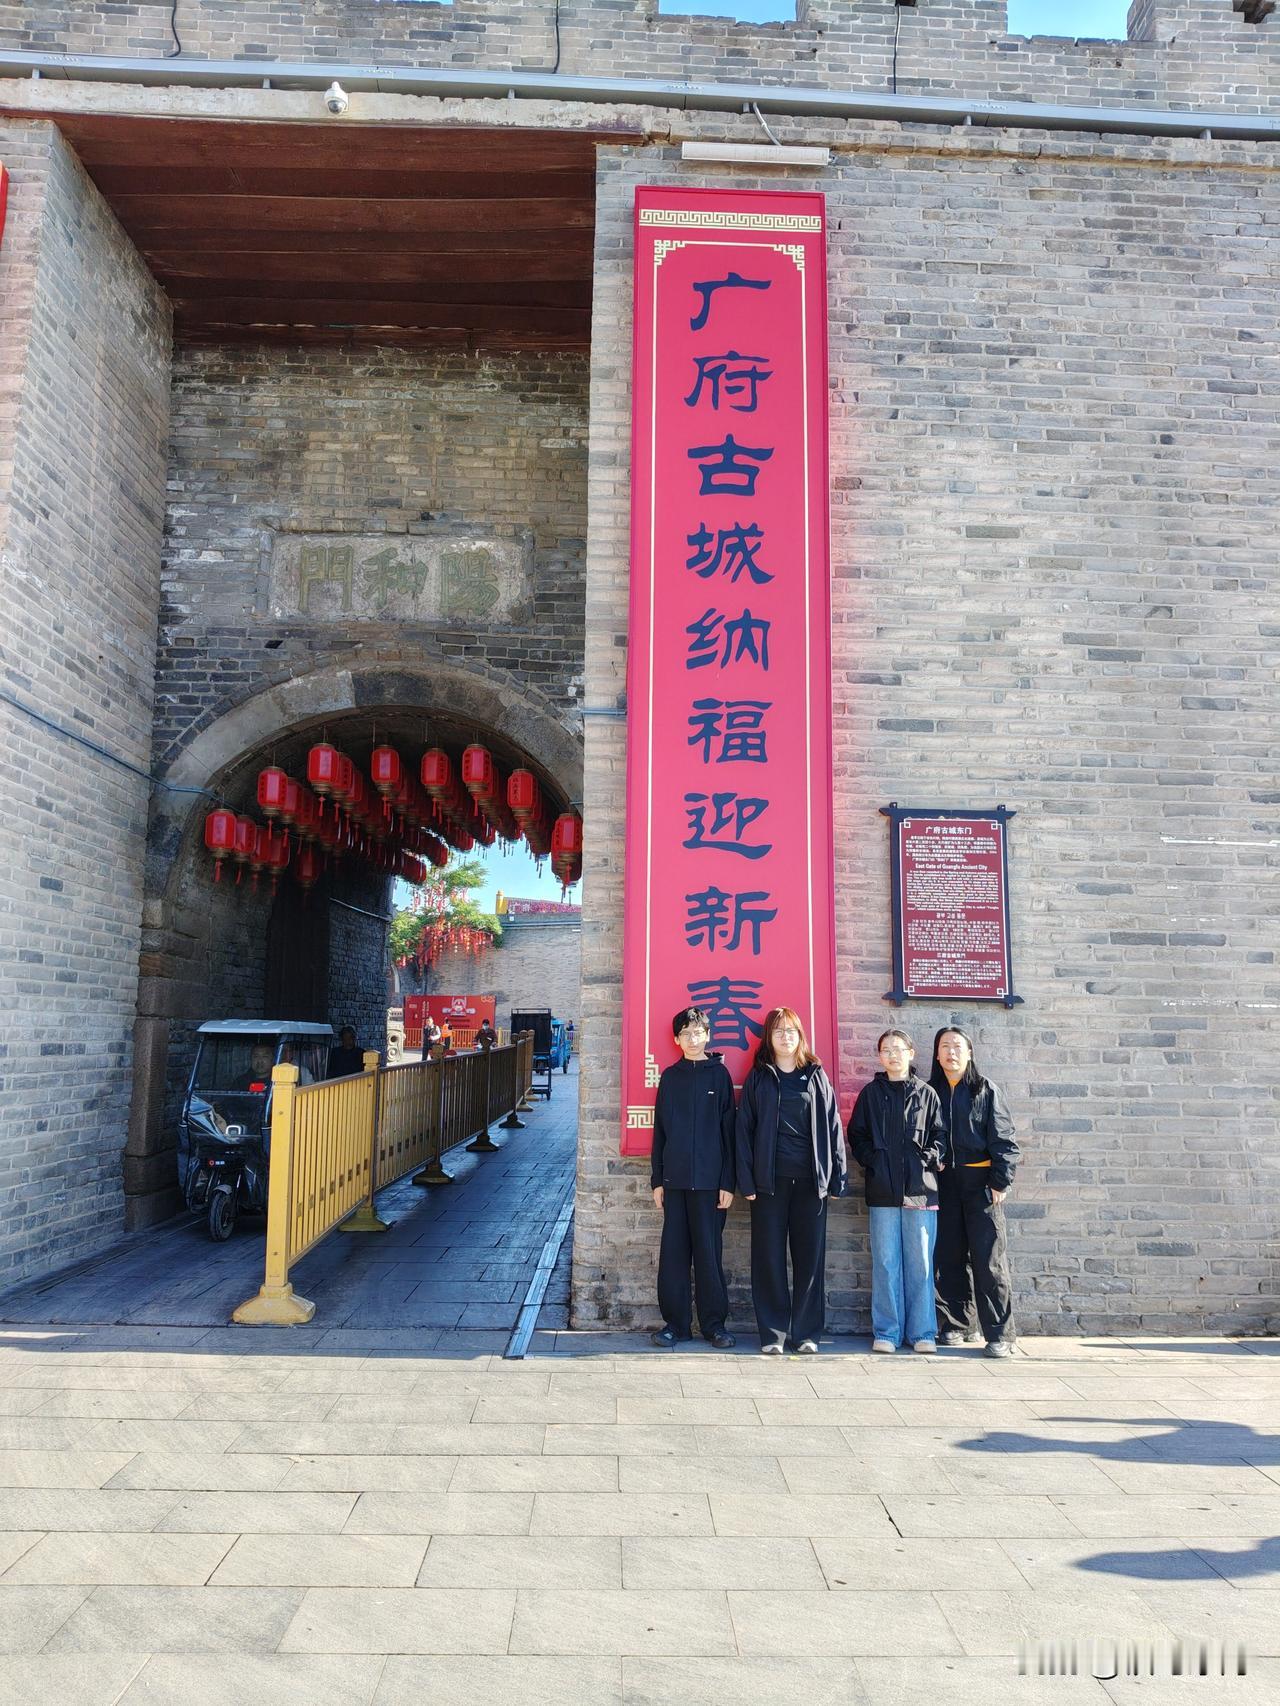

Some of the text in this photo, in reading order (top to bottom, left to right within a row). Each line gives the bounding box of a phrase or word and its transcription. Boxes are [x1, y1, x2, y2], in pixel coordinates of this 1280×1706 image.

[683, 271, 778, 1052] 广府古城纳福迎新春
[925, 826, 972, 835] 广府古城东门
